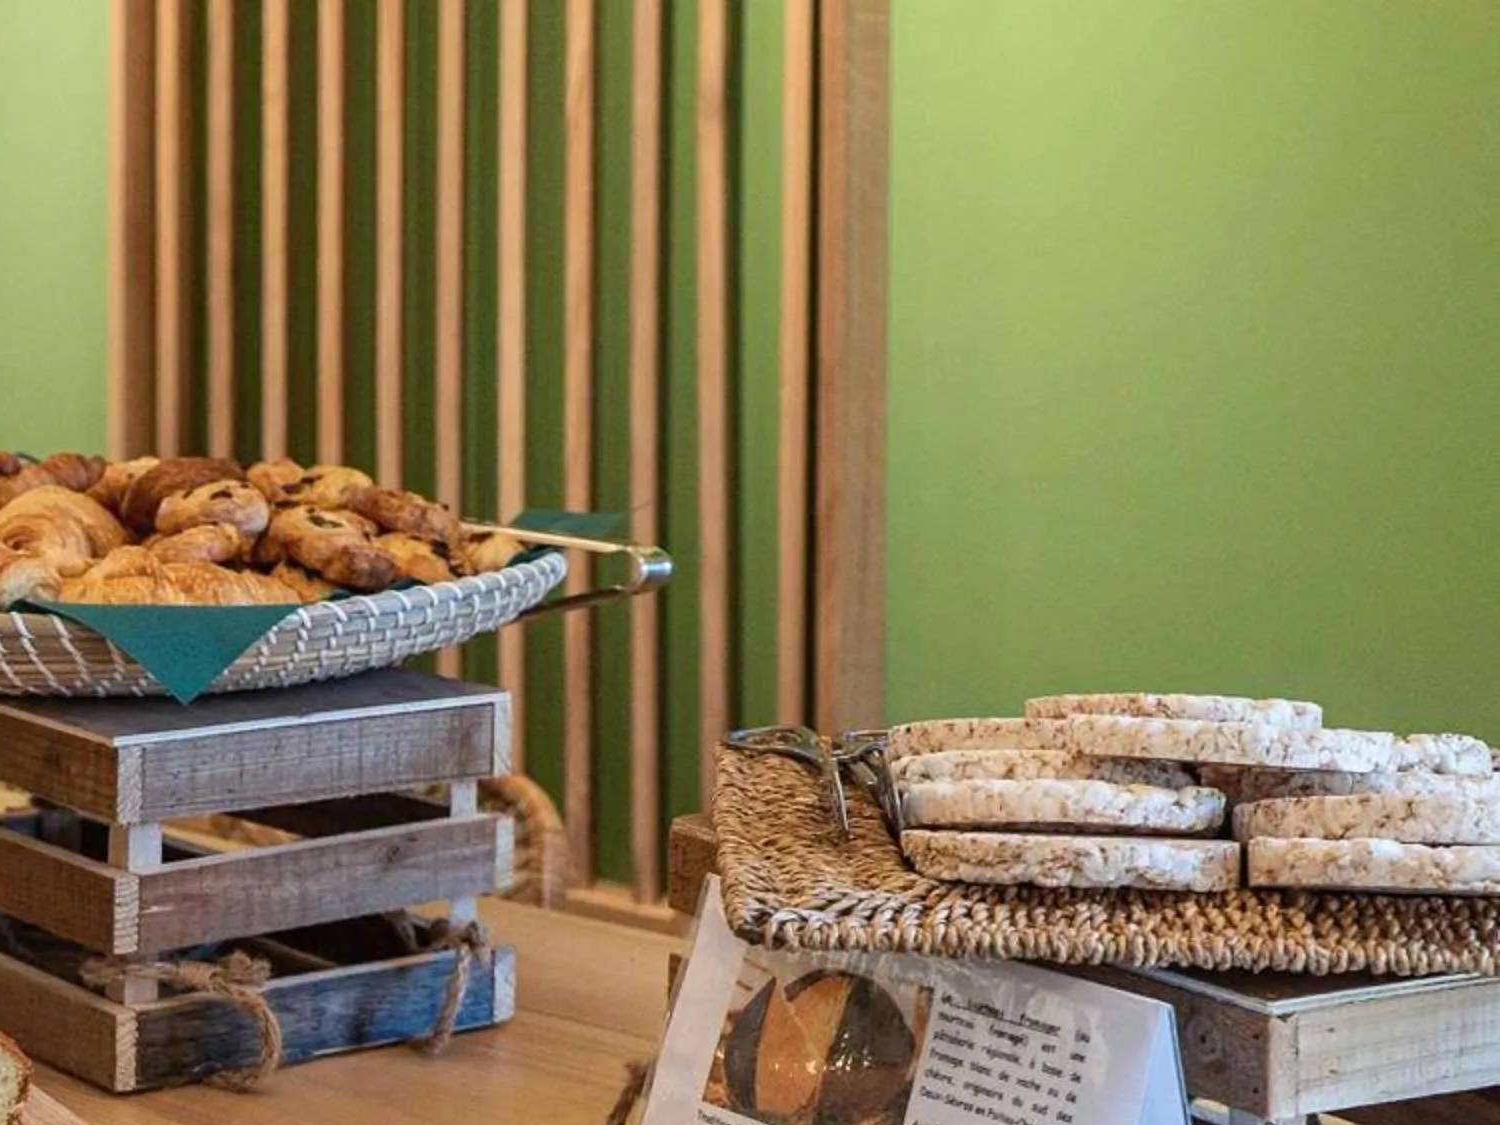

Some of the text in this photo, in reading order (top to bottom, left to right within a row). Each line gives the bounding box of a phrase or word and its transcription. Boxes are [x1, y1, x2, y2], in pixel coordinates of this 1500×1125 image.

[930, 1048, 964, 1068] fromage
[1031, 1103, 1049, 1116] sud
[1056, 1111, 1073, 1123] des
